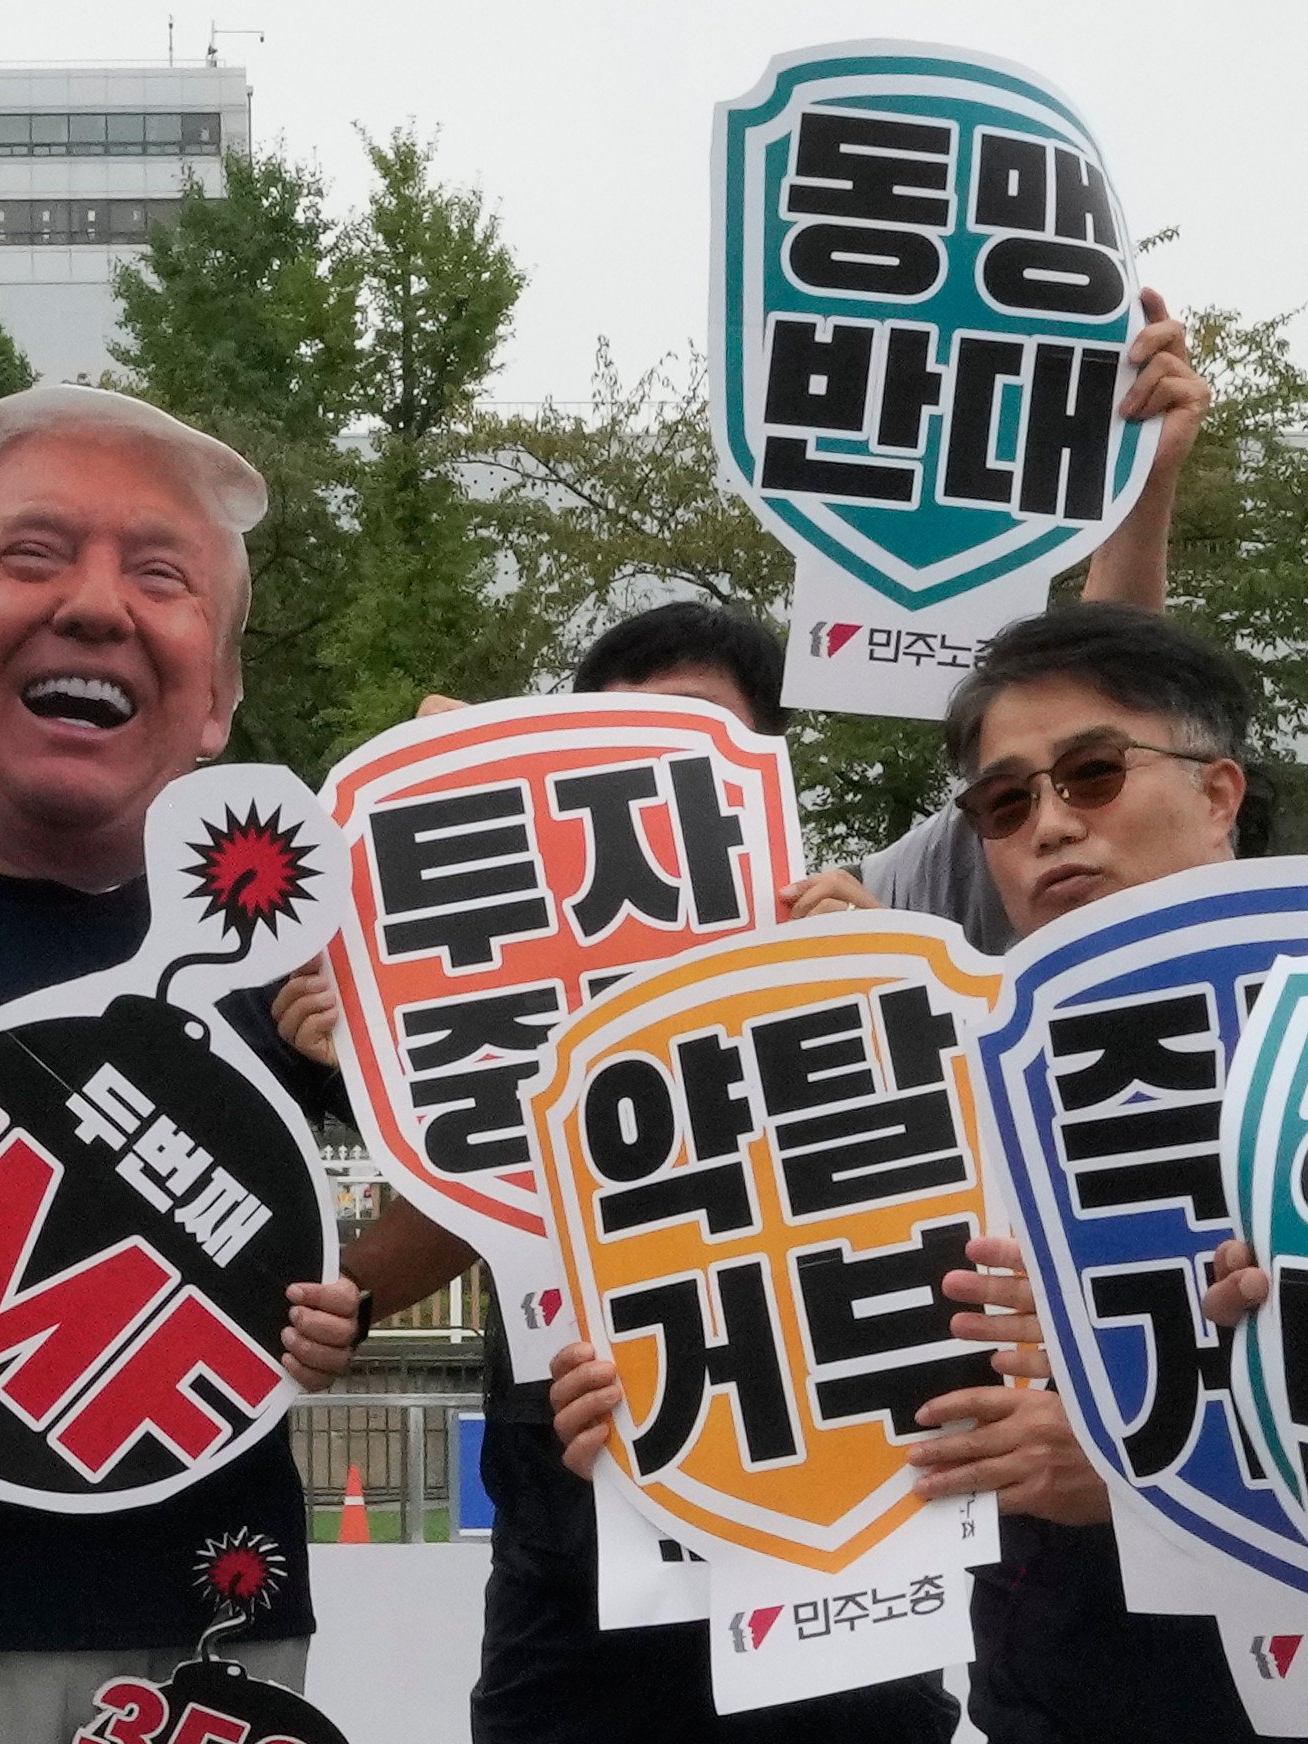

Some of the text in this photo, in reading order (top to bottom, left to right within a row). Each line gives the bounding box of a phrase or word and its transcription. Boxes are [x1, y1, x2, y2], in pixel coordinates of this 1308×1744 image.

[785, 112, 1127, 317] 동맹
[761, 320, 1120, 521] 반대
[369, 755, 745, 968] 투자
[65, 1061, 273, 1270] 두번째
[585, 984, 967, 1235] 약탈
[609, 1222, 1003, 1478] 거부
[793, 1574, 945, 1641] 민주노총
